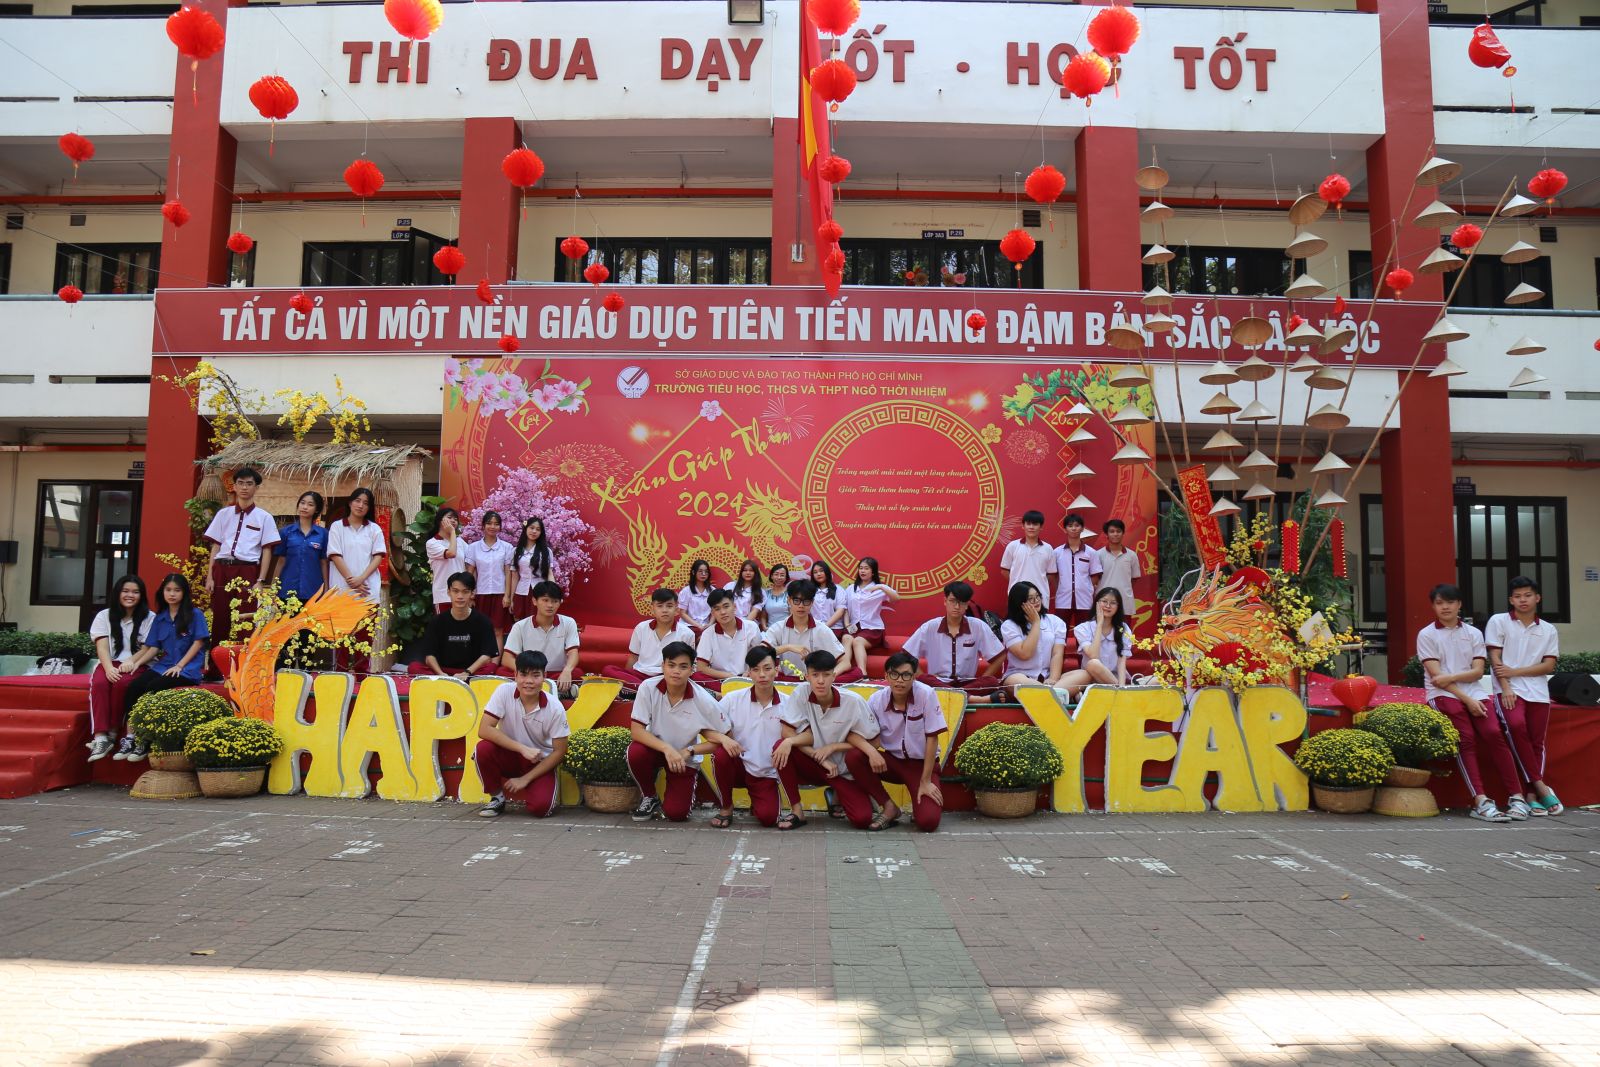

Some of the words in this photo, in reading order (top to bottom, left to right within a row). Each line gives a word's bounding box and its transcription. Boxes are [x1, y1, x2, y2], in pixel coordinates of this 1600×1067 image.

[342, 41, 430, 83] THI
[487, 37, 599, 82] ĐUA
[661, 38, 764, 92] DẠY
[1174, 32, 1276, 91] TỐT
[220, 296, 276, 341] TẤT
[285, 296, 326, 341] CẢ
[338, 299, 368, 340] VÌ
[378, 298, 450, 347] MỘT
[459, 294, 528, 339] NỀN
[539, 295, 617, 340] GIÁO
[629, 304, 697, 347] DỤC
[709, 299, 783, 340] TIÊN
[795, 296, 871, 342] TIẾN
[883, 308, 986, 344] MANG
[996, 303, 1073, 352] ĐẬM
[1165, 300, 1231, 349] SẮC
[654, 383, 704, 394] TRƯỜNG
[708, 382, 733, 394] TIỂU
[736, 384, 764, 396] HỌC,
[768, 385, 797, 395] THCS
[801, 383, 816, 395] VÀ
[820, 385, 848, 396] THPT
[852, 384, 877, 396] NGÔ
[880, 384, 908, 397] THỜI
[911, 385, 946, 398] NHIỆM
[675, 370, 691, 379] SỞ
[692, 369, 716, 379] GIÁO
[719, 371, 740, 381] DỤC
[741, 369, 755, 379] VÀ
[758, 369, 778, 379] ĐÀO
[782, 371, 800, 381] TẠO
[803, 370, 836, 380] THÀNH
[838, 370, 860, 381] PHỐ
[862, 371, 876, 381] HỒ
[879, 371, 895, 381] CHÍ
[591, 471, 667, 512] Xuân
[668, 446, 735, 481] Giáp
[731, 417, 792, 457] Thìn
[677, 491, 745, 516] 2024
[1014, 684, 1310, 814] YEAR
